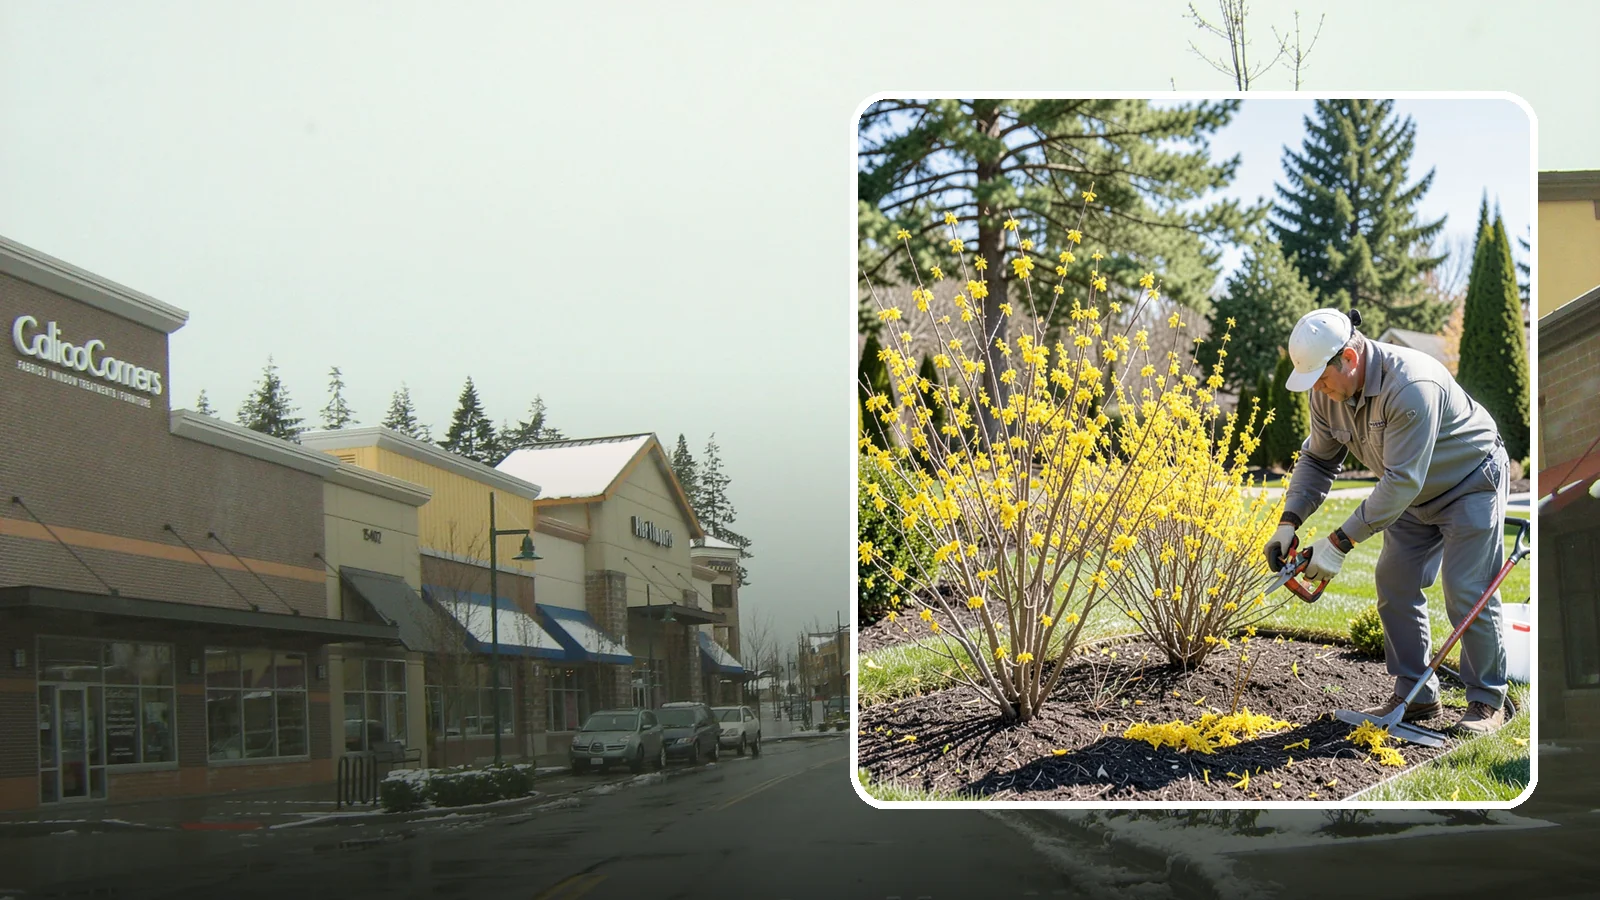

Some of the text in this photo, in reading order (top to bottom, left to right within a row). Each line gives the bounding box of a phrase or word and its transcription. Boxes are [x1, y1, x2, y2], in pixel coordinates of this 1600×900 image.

[17, 359, 151, 408] FABRICS WINDOW TREATMENTS FURNITURE
